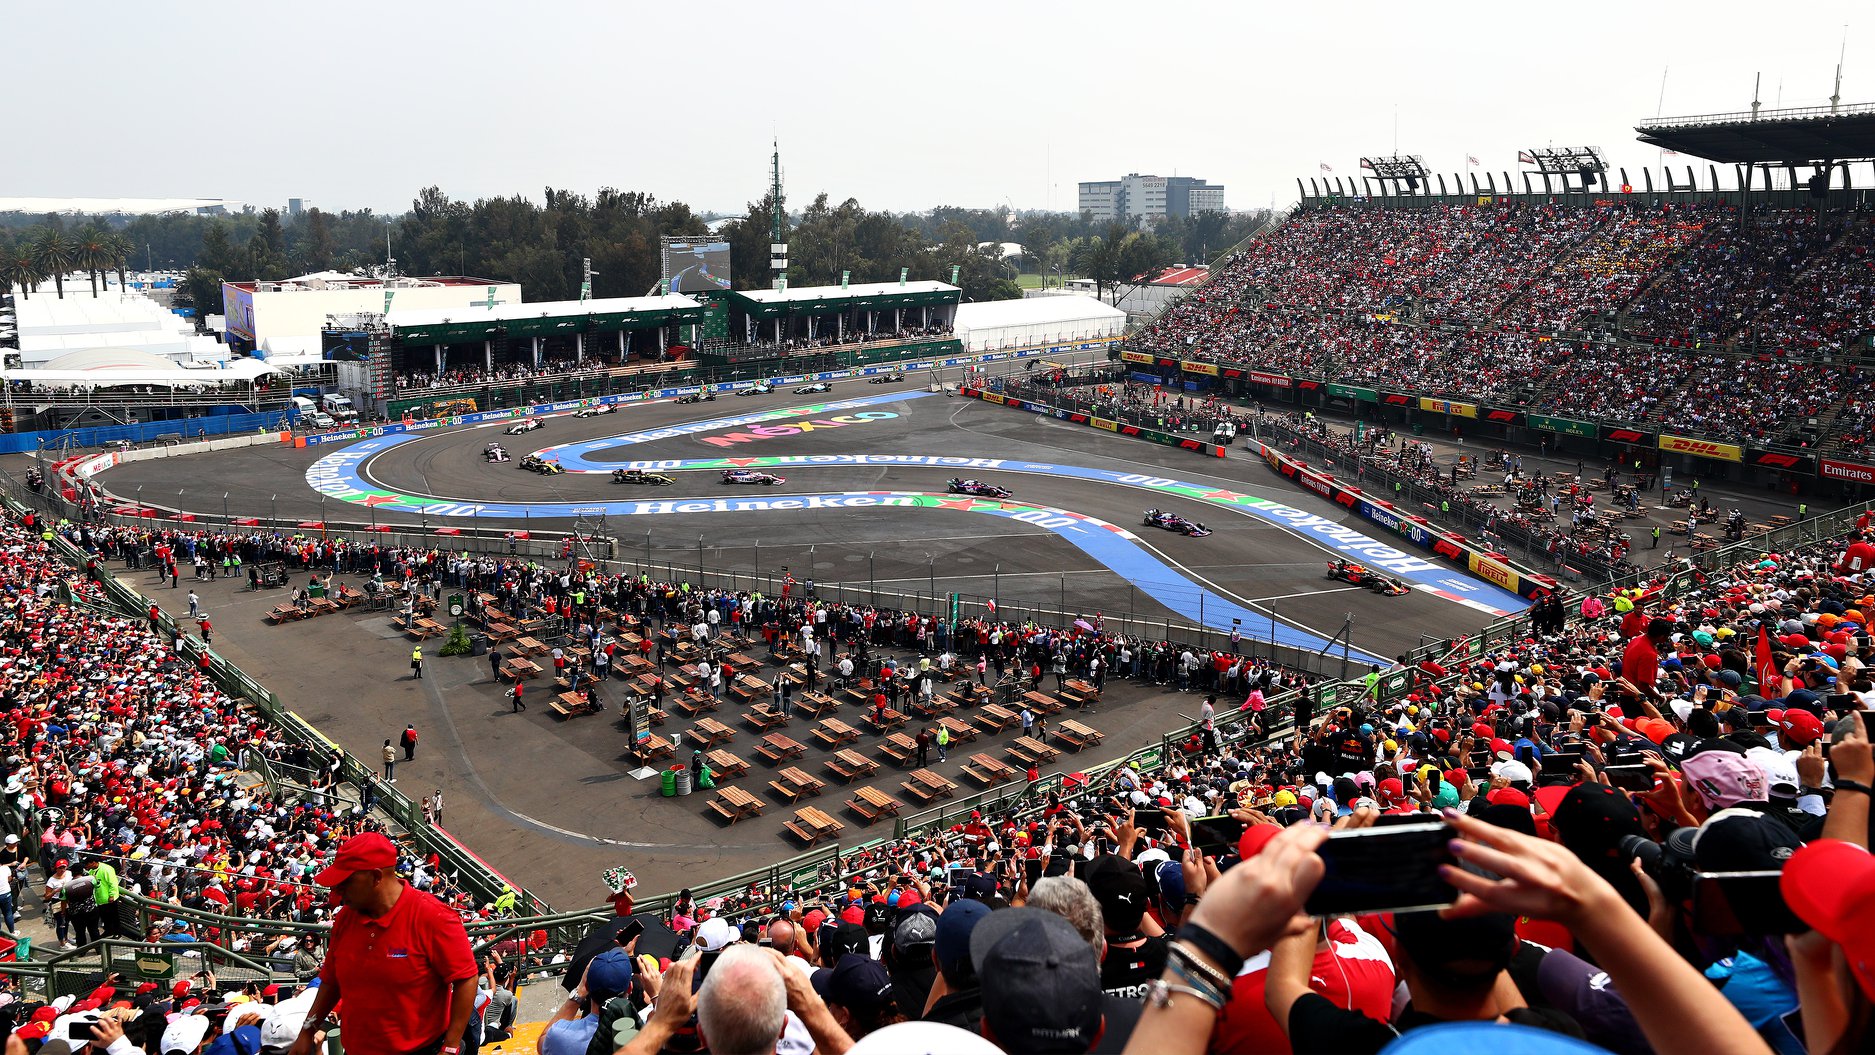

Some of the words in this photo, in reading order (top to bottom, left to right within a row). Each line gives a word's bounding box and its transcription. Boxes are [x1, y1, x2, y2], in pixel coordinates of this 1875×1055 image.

[1126, 353, 1145, 362] DHL
[1186, 364, 1208, 373] DHL
[1251, 375, 1271, 383] Emirates
[617, 394, 642, 402] Heineken
[984, 394, 1001, 402] DHL
[553, 402, 580, 411] Heineken
[1031, 404, 1048, 413] Heineken
[482, 411, 512, 420] Heineken
[406, 420, 438, 431] Heineken
[617, 414, 787, 443] Heineken
[1096, 420, 1112, 429] PIRELLI
[321, 432, 356, 443] Heineken
[1672, 440, 1721, 456] DHL
[779, 455, 1007, 468] Heineken
[306, 452, 370, 499] Heineken
[1824, 464, 1872, 480] Emirates
[631, 496, 914, 514] Heineken
[1371, 509, 1398, 530] Heineken
[1248, 501, 1446, 573] Heineken
[1478, 560, 1508, 585] PIRELLI
